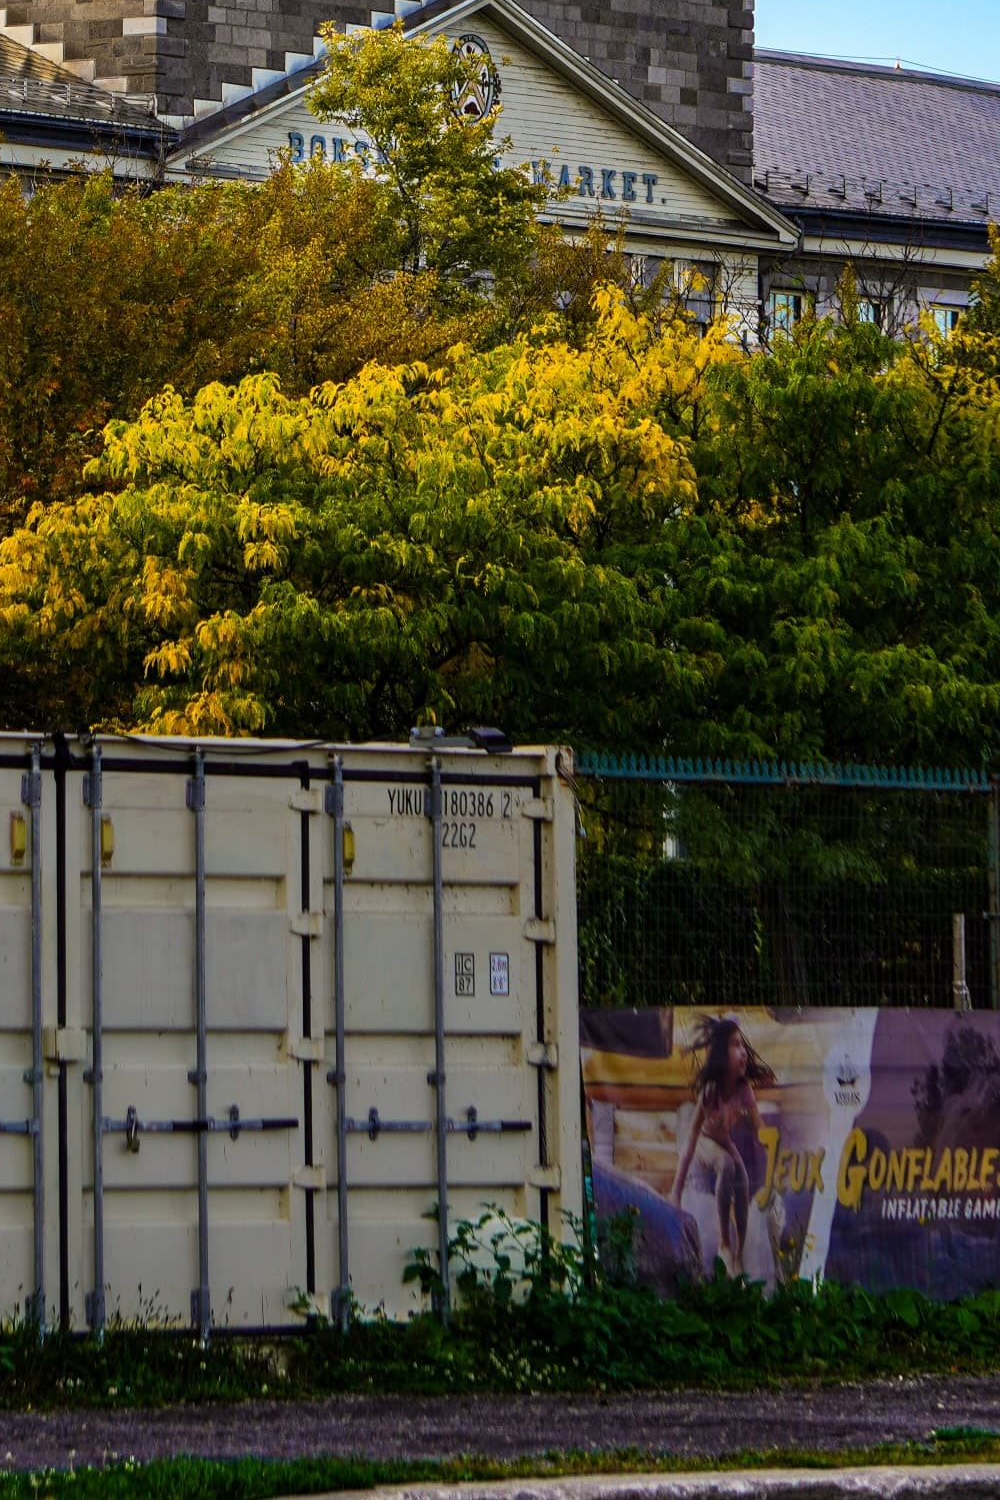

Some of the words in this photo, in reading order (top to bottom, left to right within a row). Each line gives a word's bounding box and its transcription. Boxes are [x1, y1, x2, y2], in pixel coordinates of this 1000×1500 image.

[387, 788, 422, 816] YUKU
[443, 790, 494, 818] 180386
[503, 792, 511, 819] 2
[442, 822, 476, 849] 22G2
[836, 1126, 1000, 1212] GONFLABLE
